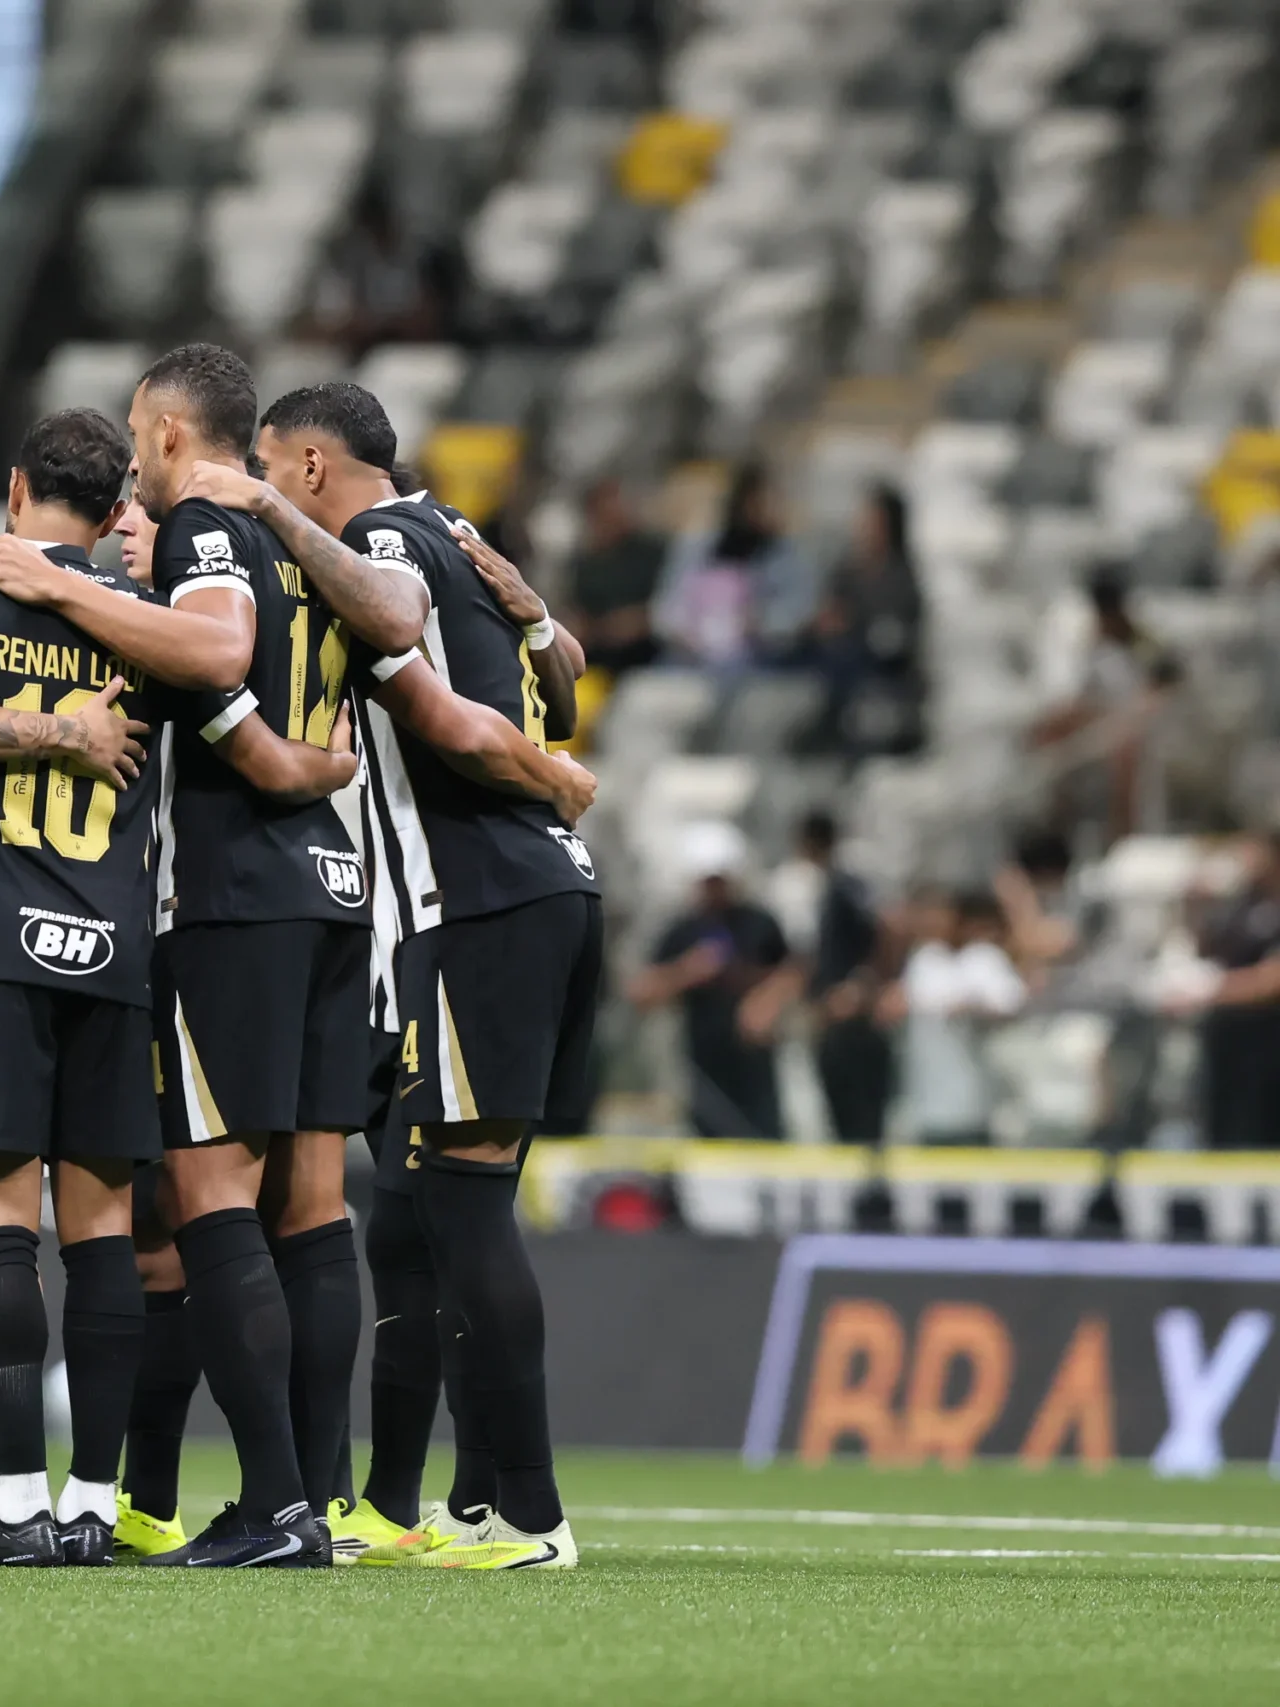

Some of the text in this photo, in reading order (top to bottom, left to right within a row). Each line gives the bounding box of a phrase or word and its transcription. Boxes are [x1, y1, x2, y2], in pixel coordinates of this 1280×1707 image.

[325, 859, 360, 896] BH
[19, 906, 116, 931] SUPERMERCADOS
[33, 922, 98, 964] BH
[402, 1020, 419, 1073] 4
[799, 1298, 1273, 1479] BRAX
